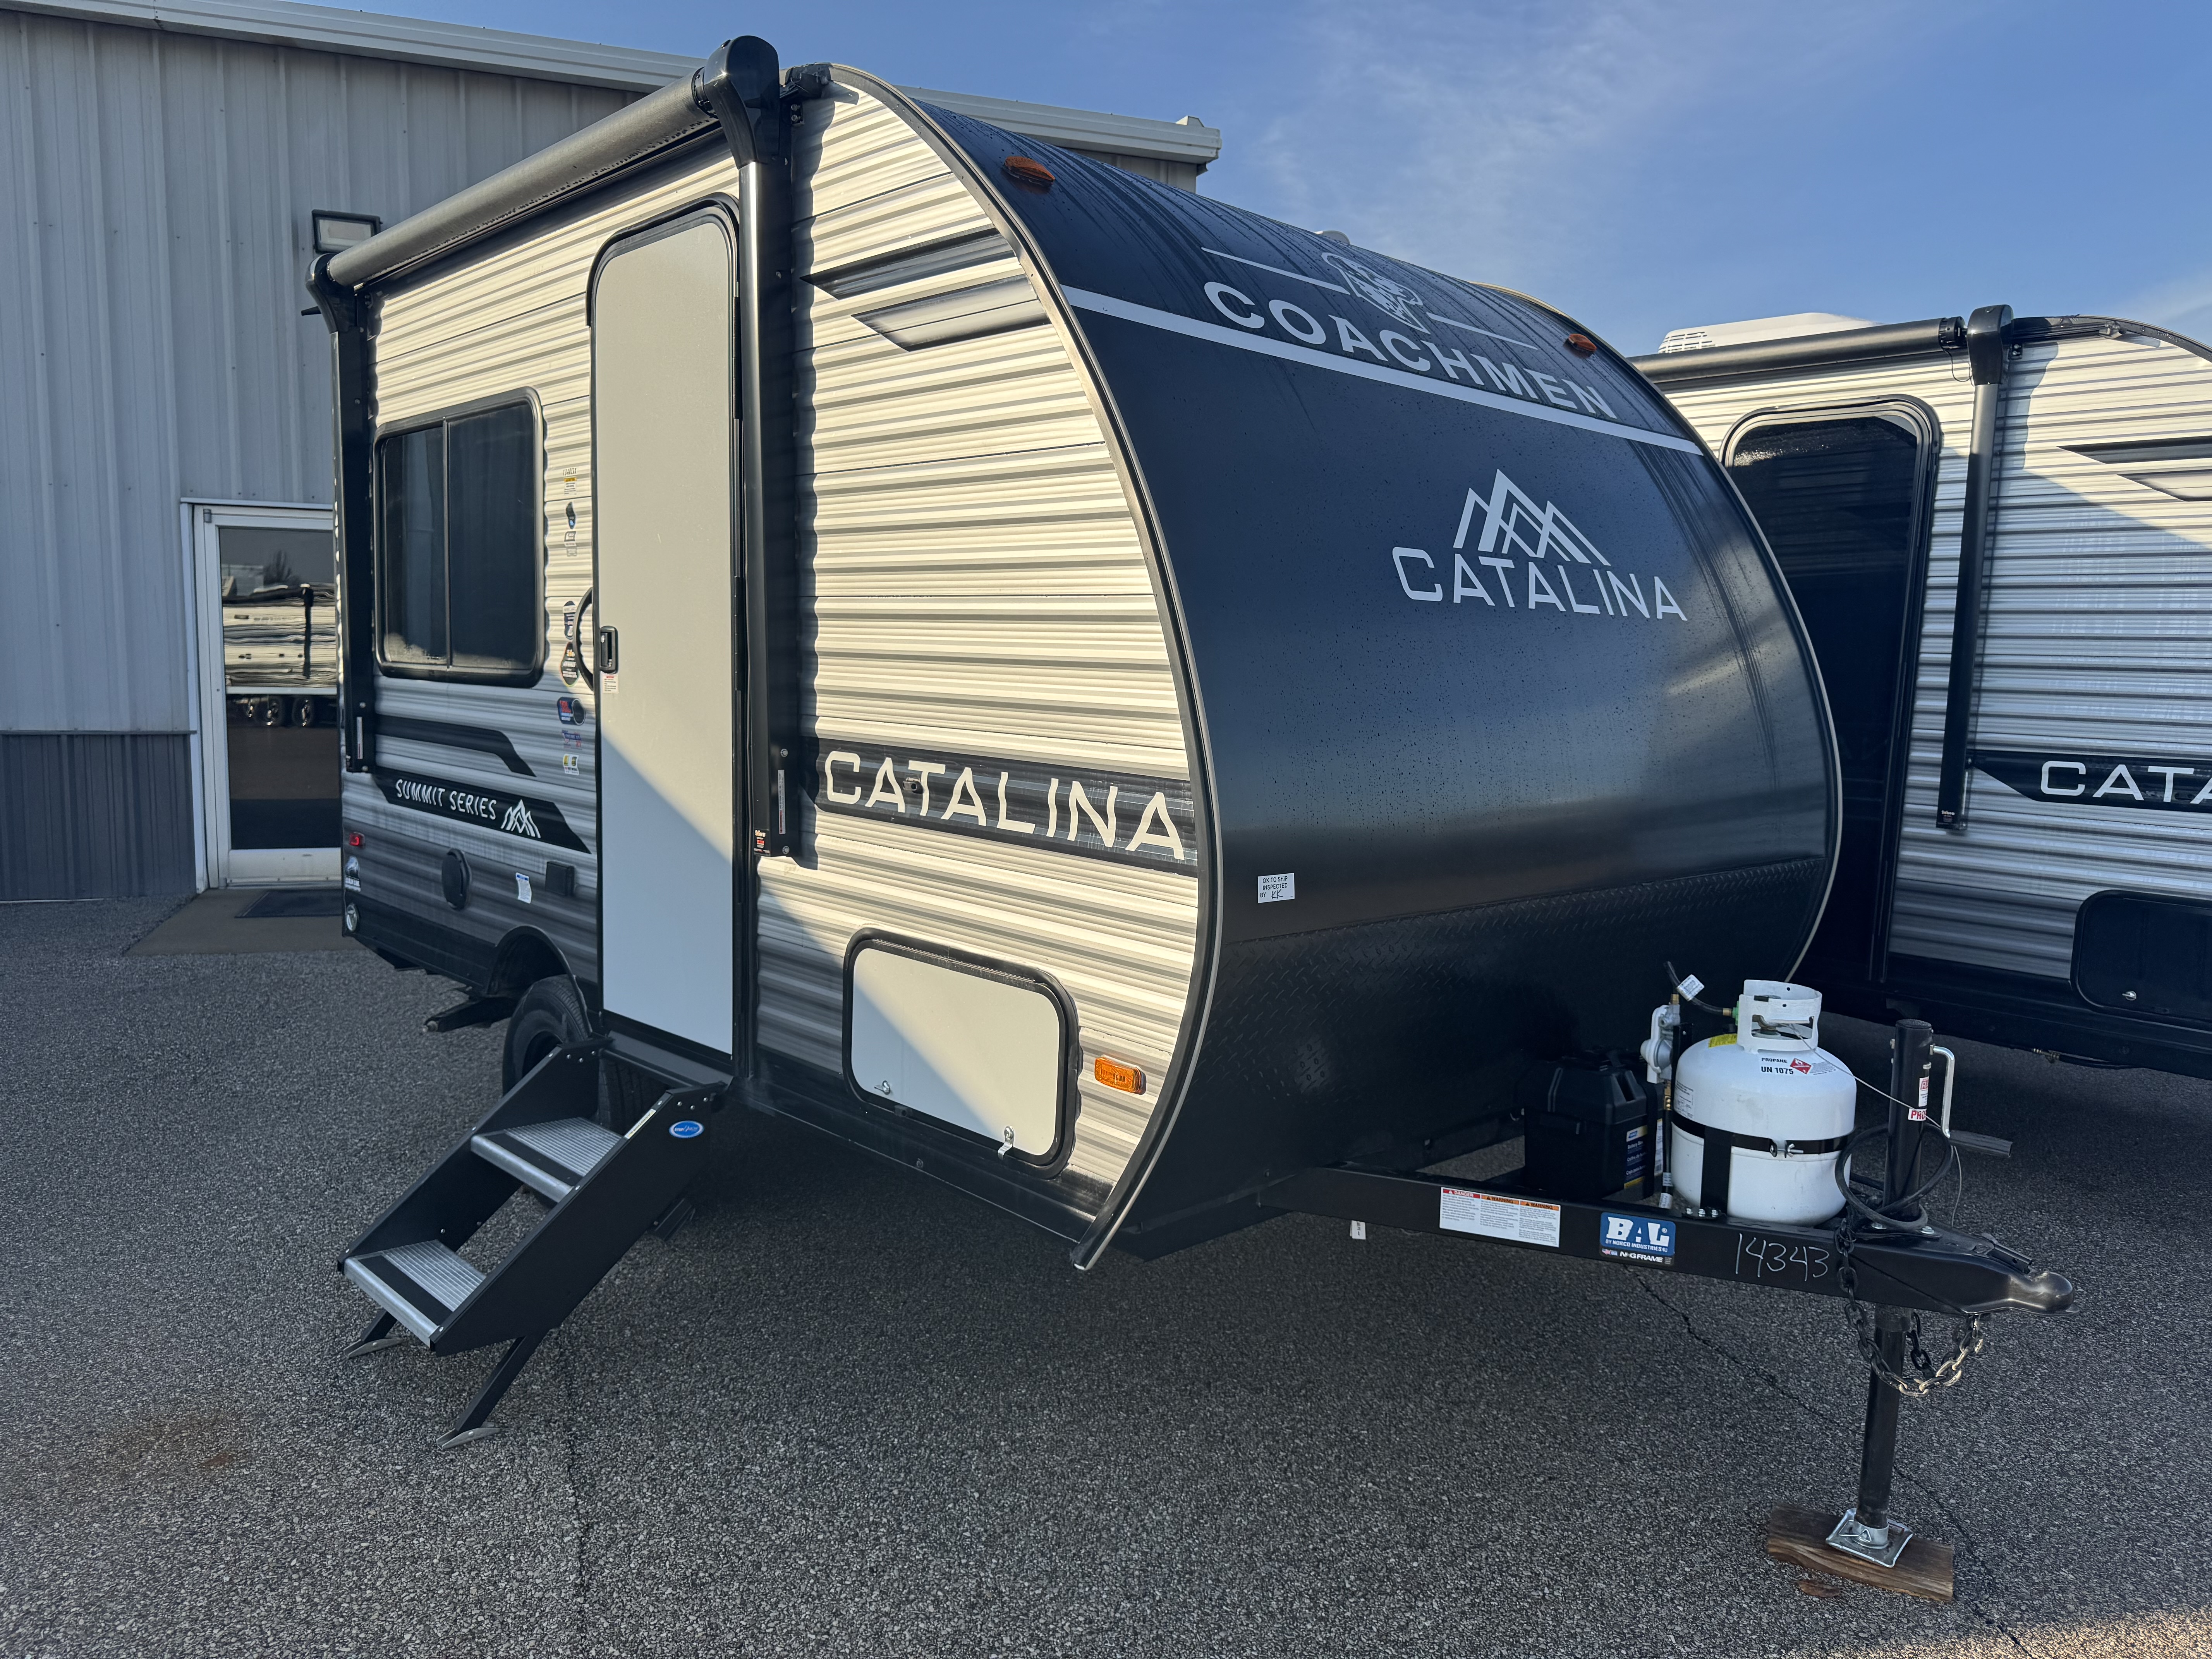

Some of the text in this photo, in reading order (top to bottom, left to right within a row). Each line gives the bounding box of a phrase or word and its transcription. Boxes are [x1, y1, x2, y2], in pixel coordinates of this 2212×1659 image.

[1204, 282, 1617, 419] COACHMEN
[1393, 547, 1688, 621] CATALINA
[395, 779, 496, 820] SUMMIT SERIES
[825, 751, 1185, 860] CATALINA
[1606, 1217, 1669, 1247] BAL
[1632, 1243, 1662, 1251] INDUSTRIES
[1736, 1233, 1829, 1281] 14343
